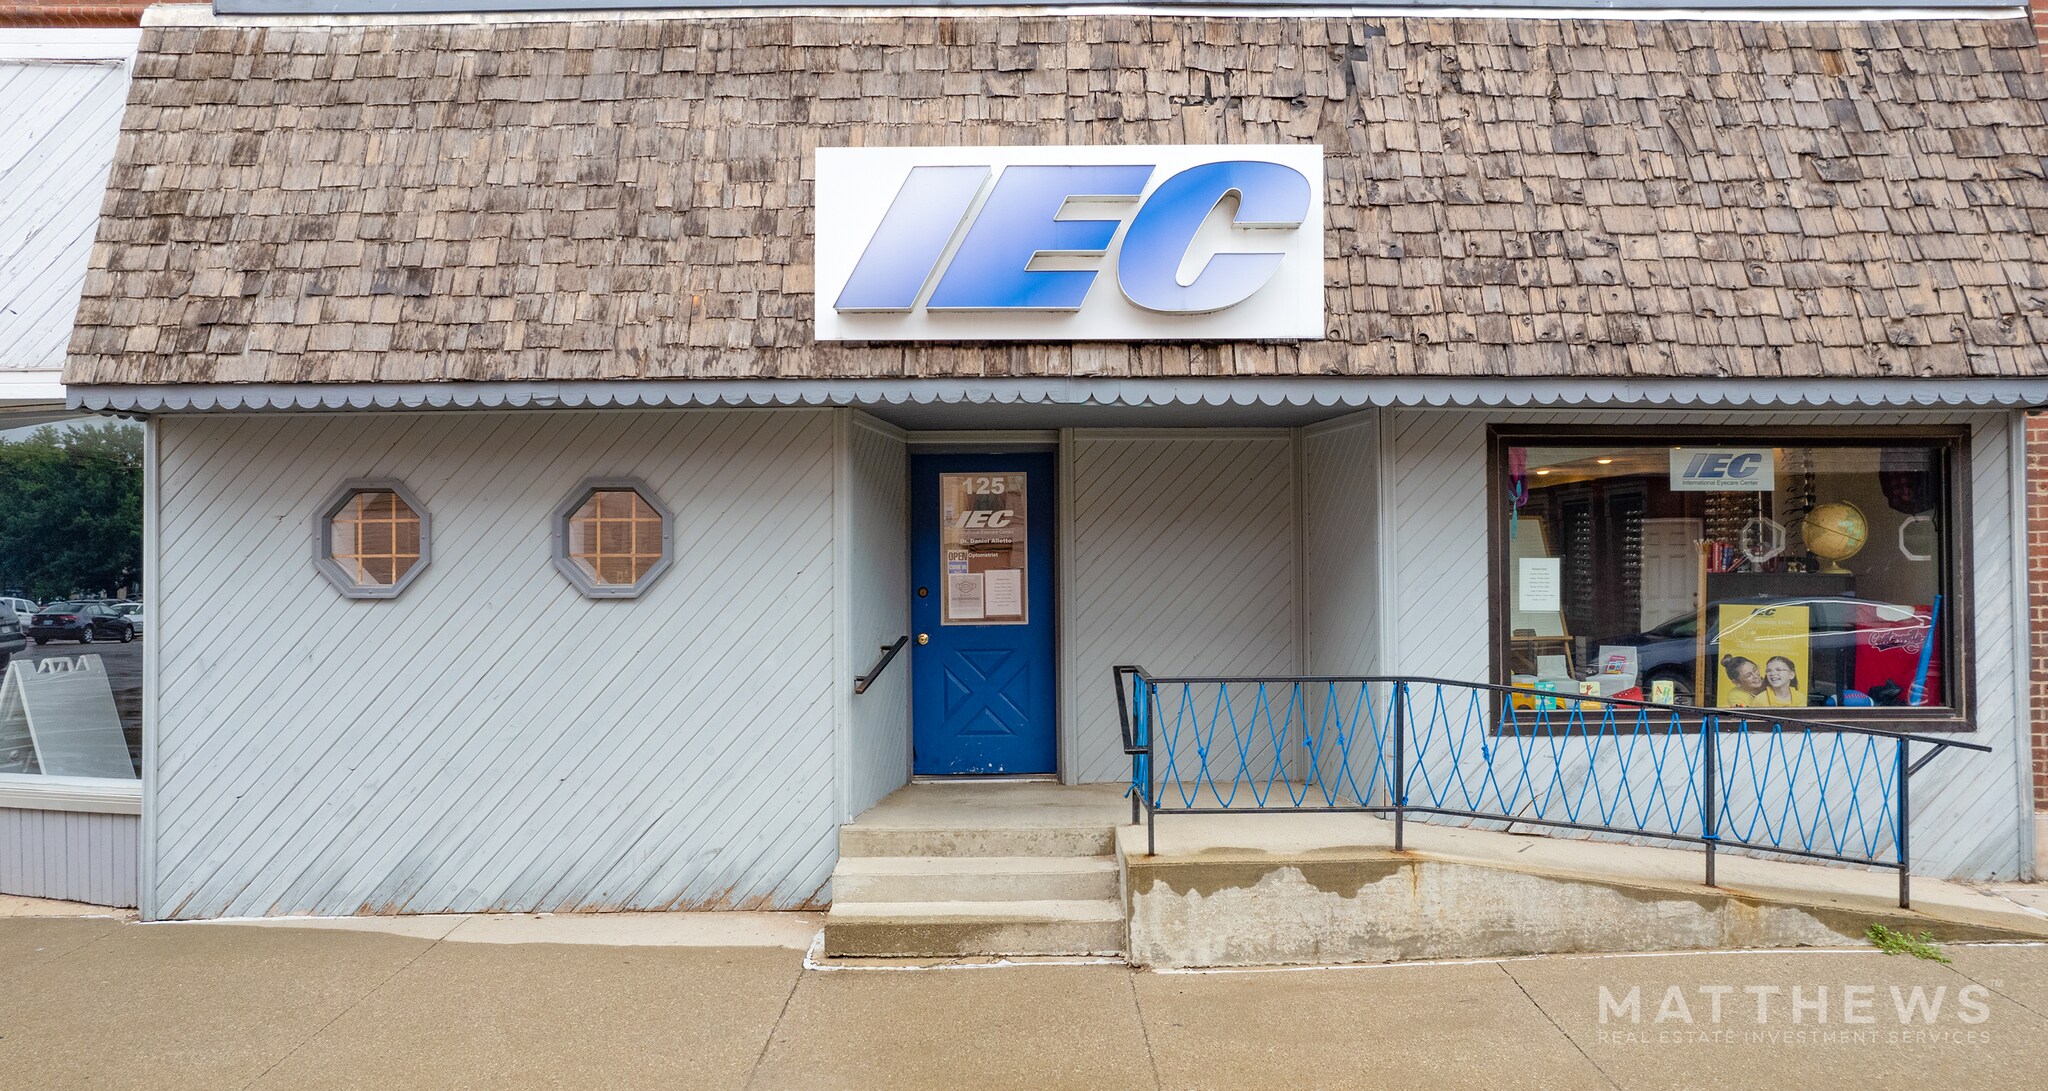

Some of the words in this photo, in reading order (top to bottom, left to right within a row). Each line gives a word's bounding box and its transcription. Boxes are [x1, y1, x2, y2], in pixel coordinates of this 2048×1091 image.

[833, 160, 1311, 314] IEC
[1682, 452, 1762, 478] IEC
[963, 477, 1005, 495] 125
[1716, 479, 1739, 487] Eyecare
[954, 510, 1014, 529] IEC
[949, 552, 967, 561] OPEN
